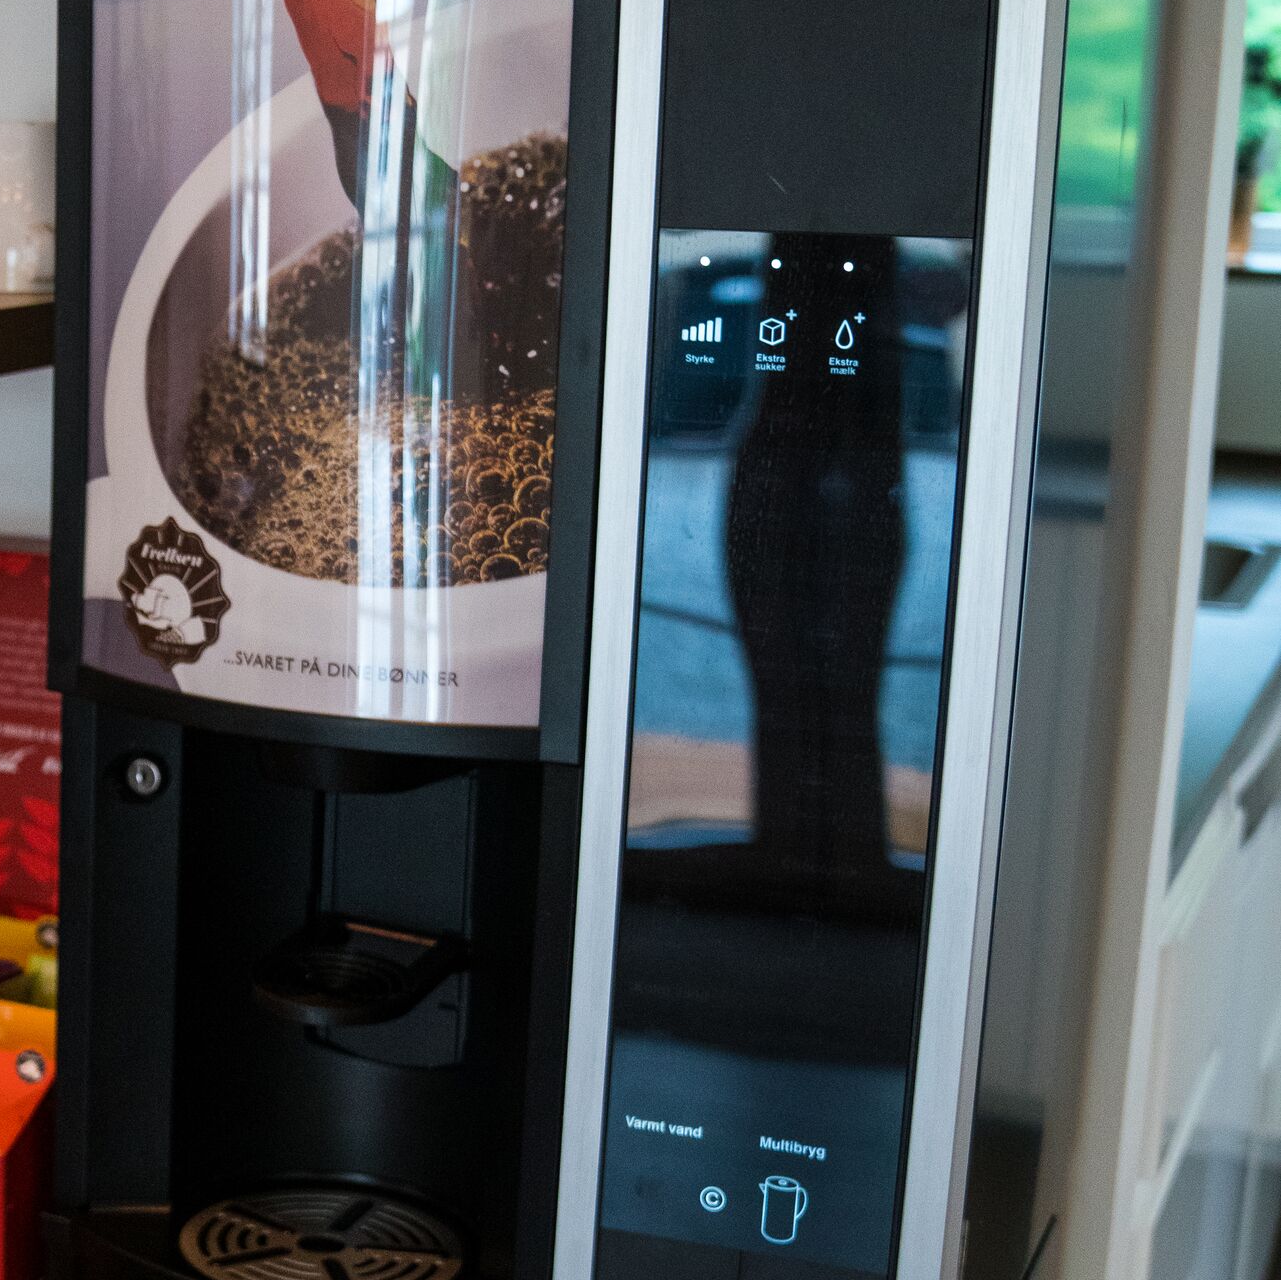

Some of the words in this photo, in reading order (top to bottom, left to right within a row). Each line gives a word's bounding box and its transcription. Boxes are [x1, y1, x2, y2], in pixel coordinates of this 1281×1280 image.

[685, 353, 715, 365] Styrke
[756, 353, 786, 364] Ekstra
[828, 357, 859, 368] Ekstra
[755, 362, 786, 372] sukker
[830, 366, 857, 376] mælk
[300, 655, 322, 676] PÅ
[327, 662, 372, 681] DINE
[625, 1114, 666, 1133] Varmt
[669, 1124, 704, 1140] vand
[759, 1135, 827, 1161] Multibryg
